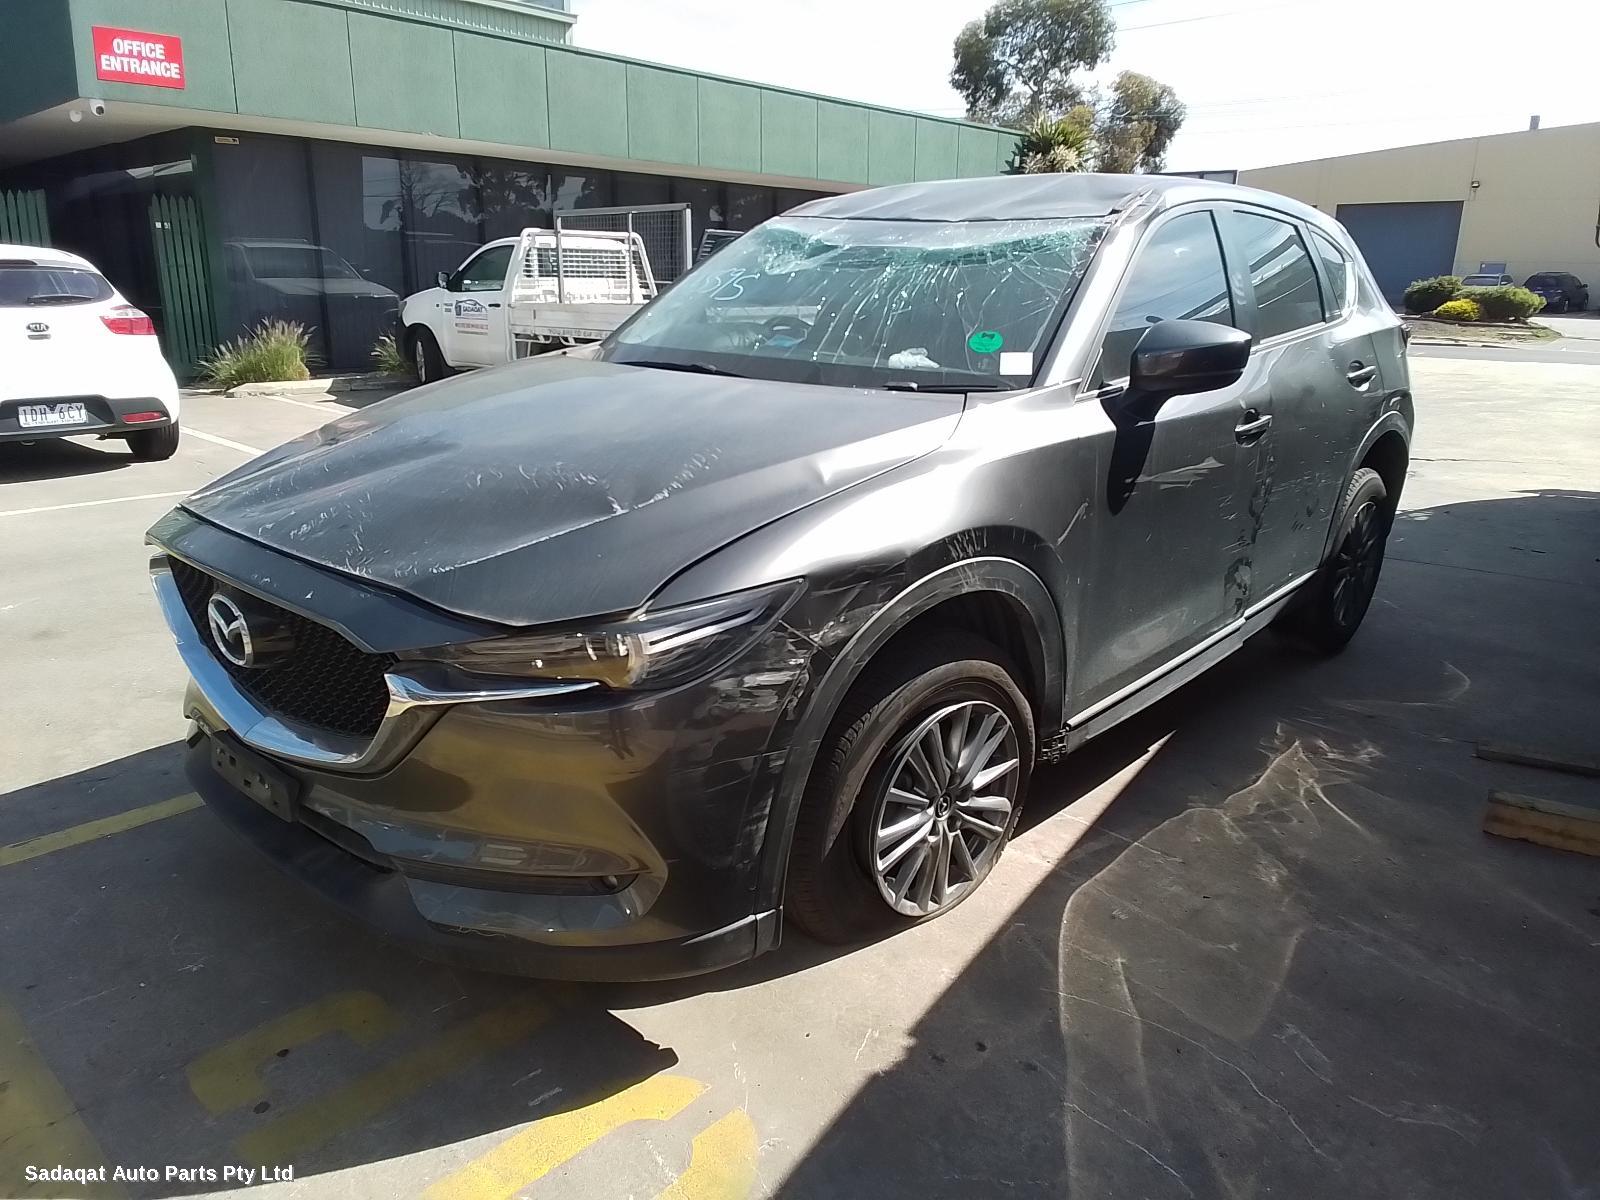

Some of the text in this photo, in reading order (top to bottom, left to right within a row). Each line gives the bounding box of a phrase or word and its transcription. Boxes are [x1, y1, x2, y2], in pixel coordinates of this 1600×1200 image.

[112, 38, 166, 60] OFFICE
[100, 54, 181, 79] ENTRANCE
[29, 323, 48, 332] KIA
